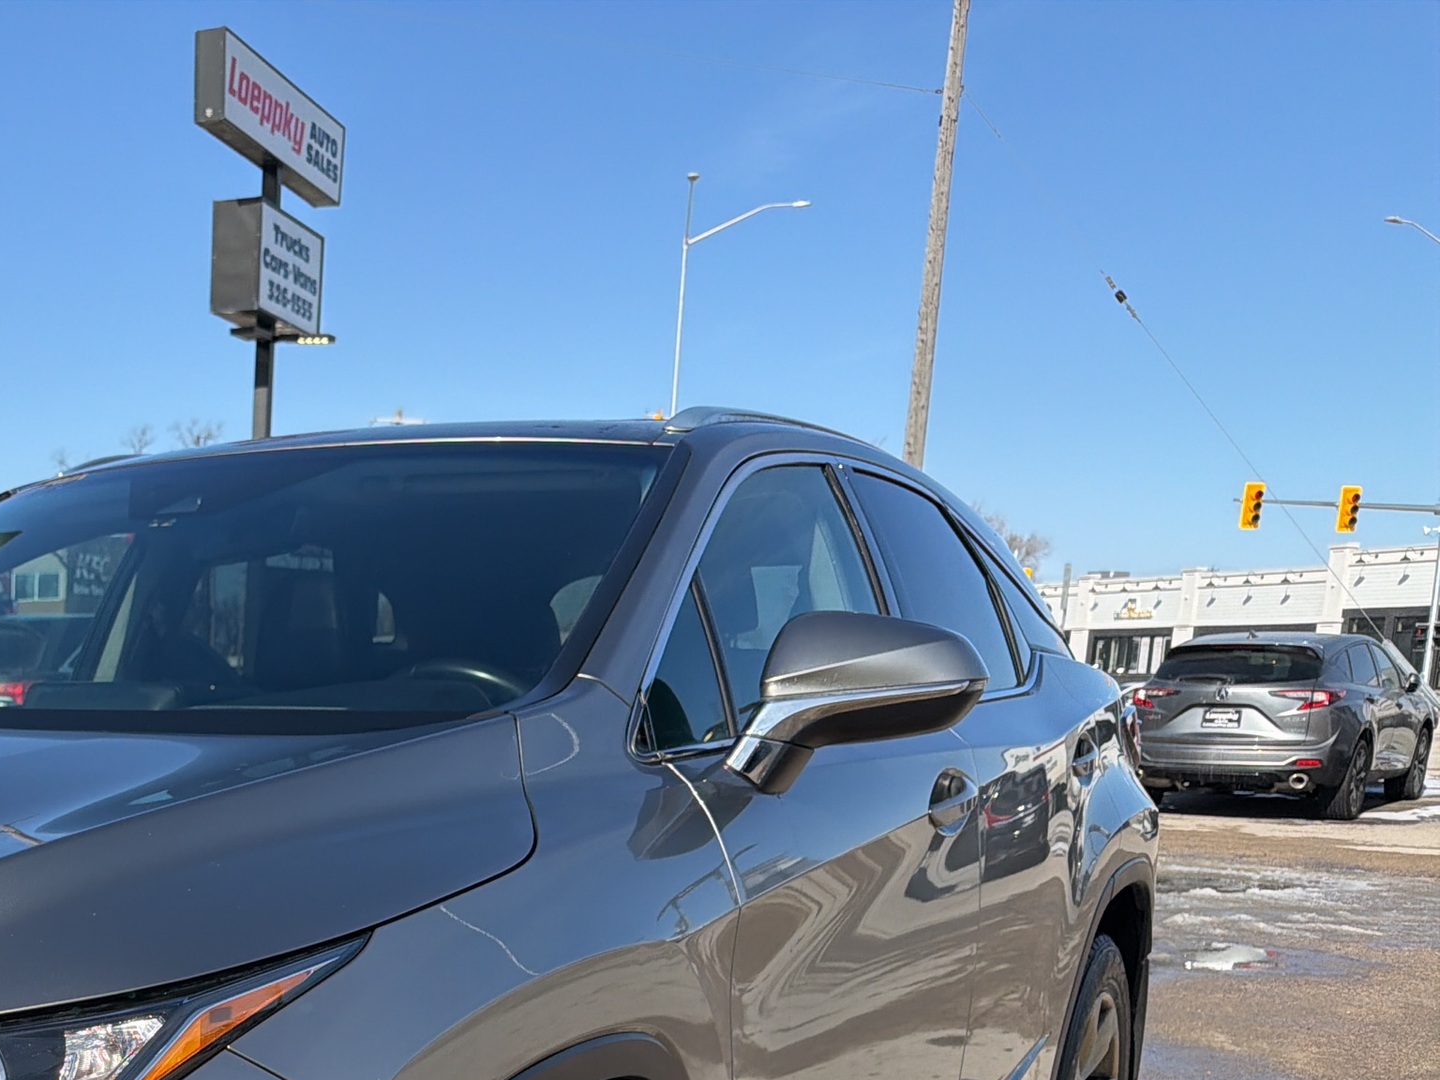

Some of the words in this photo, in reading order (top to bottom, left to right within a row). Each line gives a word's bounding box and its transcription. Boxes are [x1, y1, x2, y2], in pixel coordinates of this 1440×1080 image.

[227, 55, 306, 156] Loeppky
[309, 120, 338, 158] AUTO
[305, 142, 339, 184] SALES
[272, 222, 310, 264] Trucks
